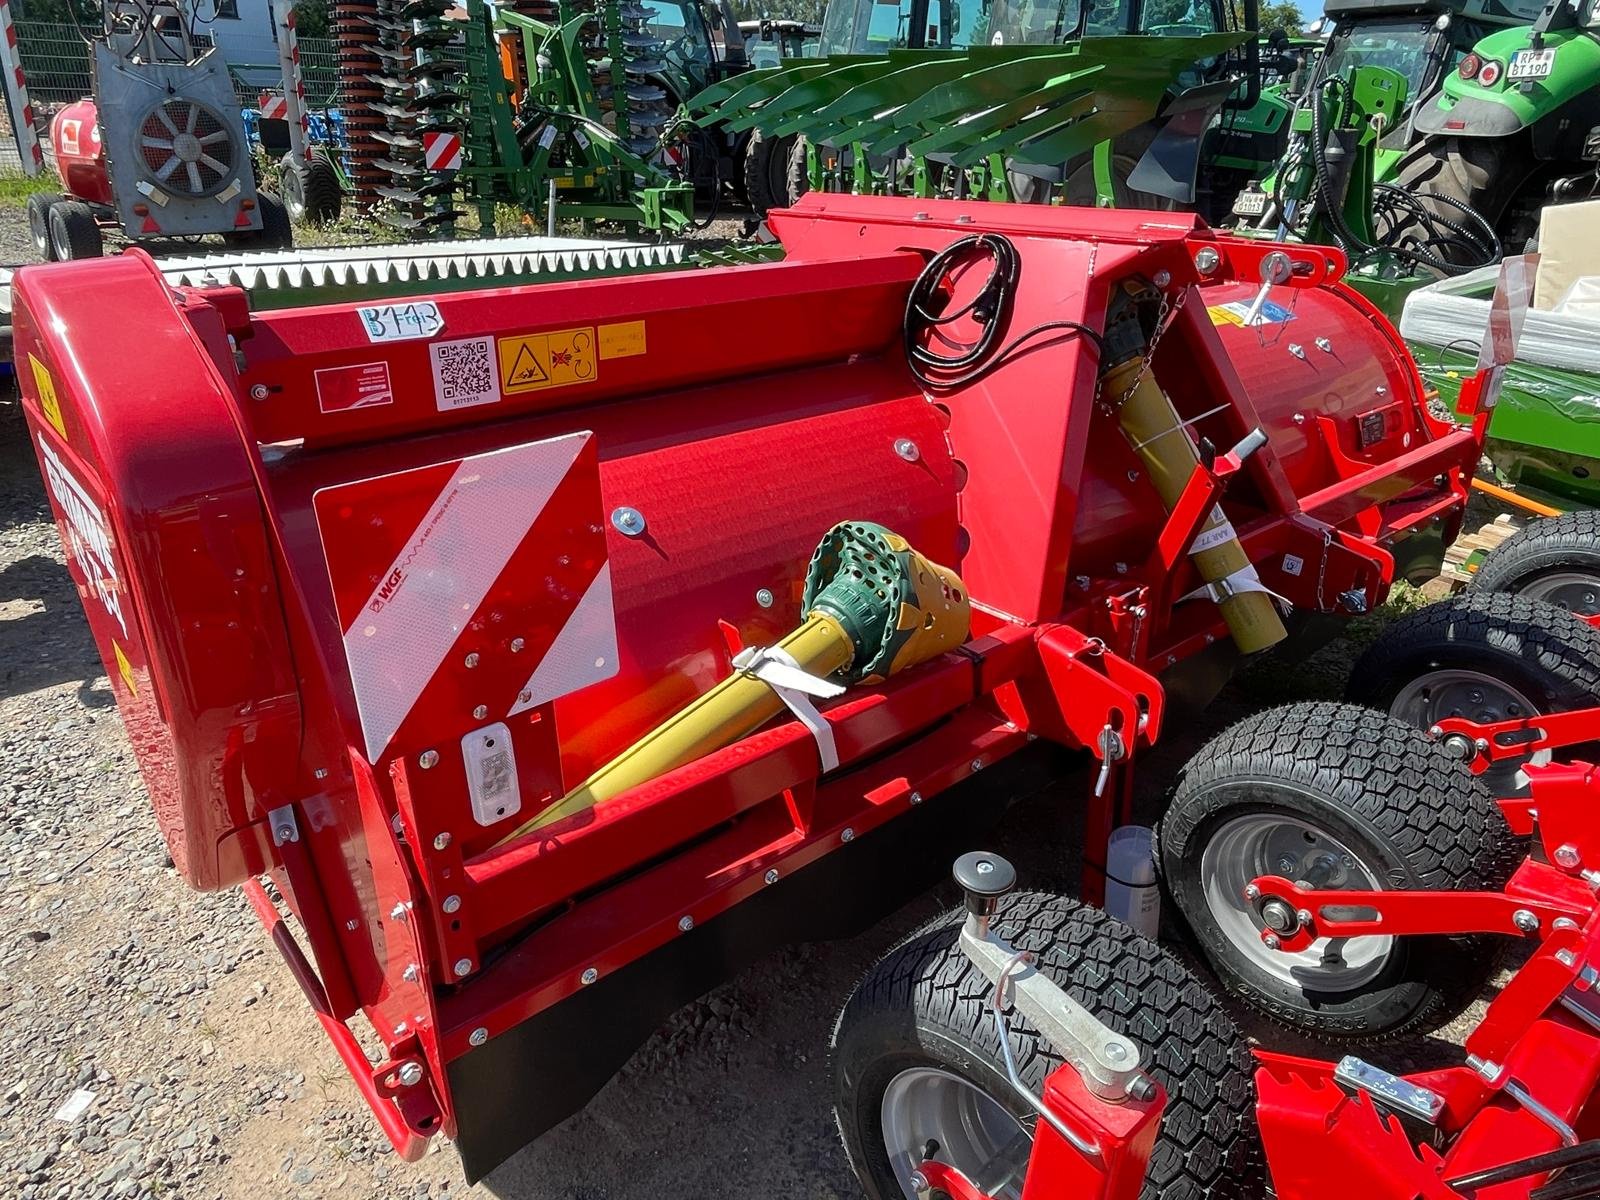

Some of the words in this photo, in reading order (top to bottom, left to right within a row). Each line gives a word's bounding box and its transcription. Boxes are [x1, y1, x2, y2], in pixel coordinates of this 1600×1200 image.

[1520, 52, 1536, 64] RP
[1511, 64, 1527, 76] BT
[1528, 63, 1548, 75] 190
[378, 567, 402, 600] WGF
